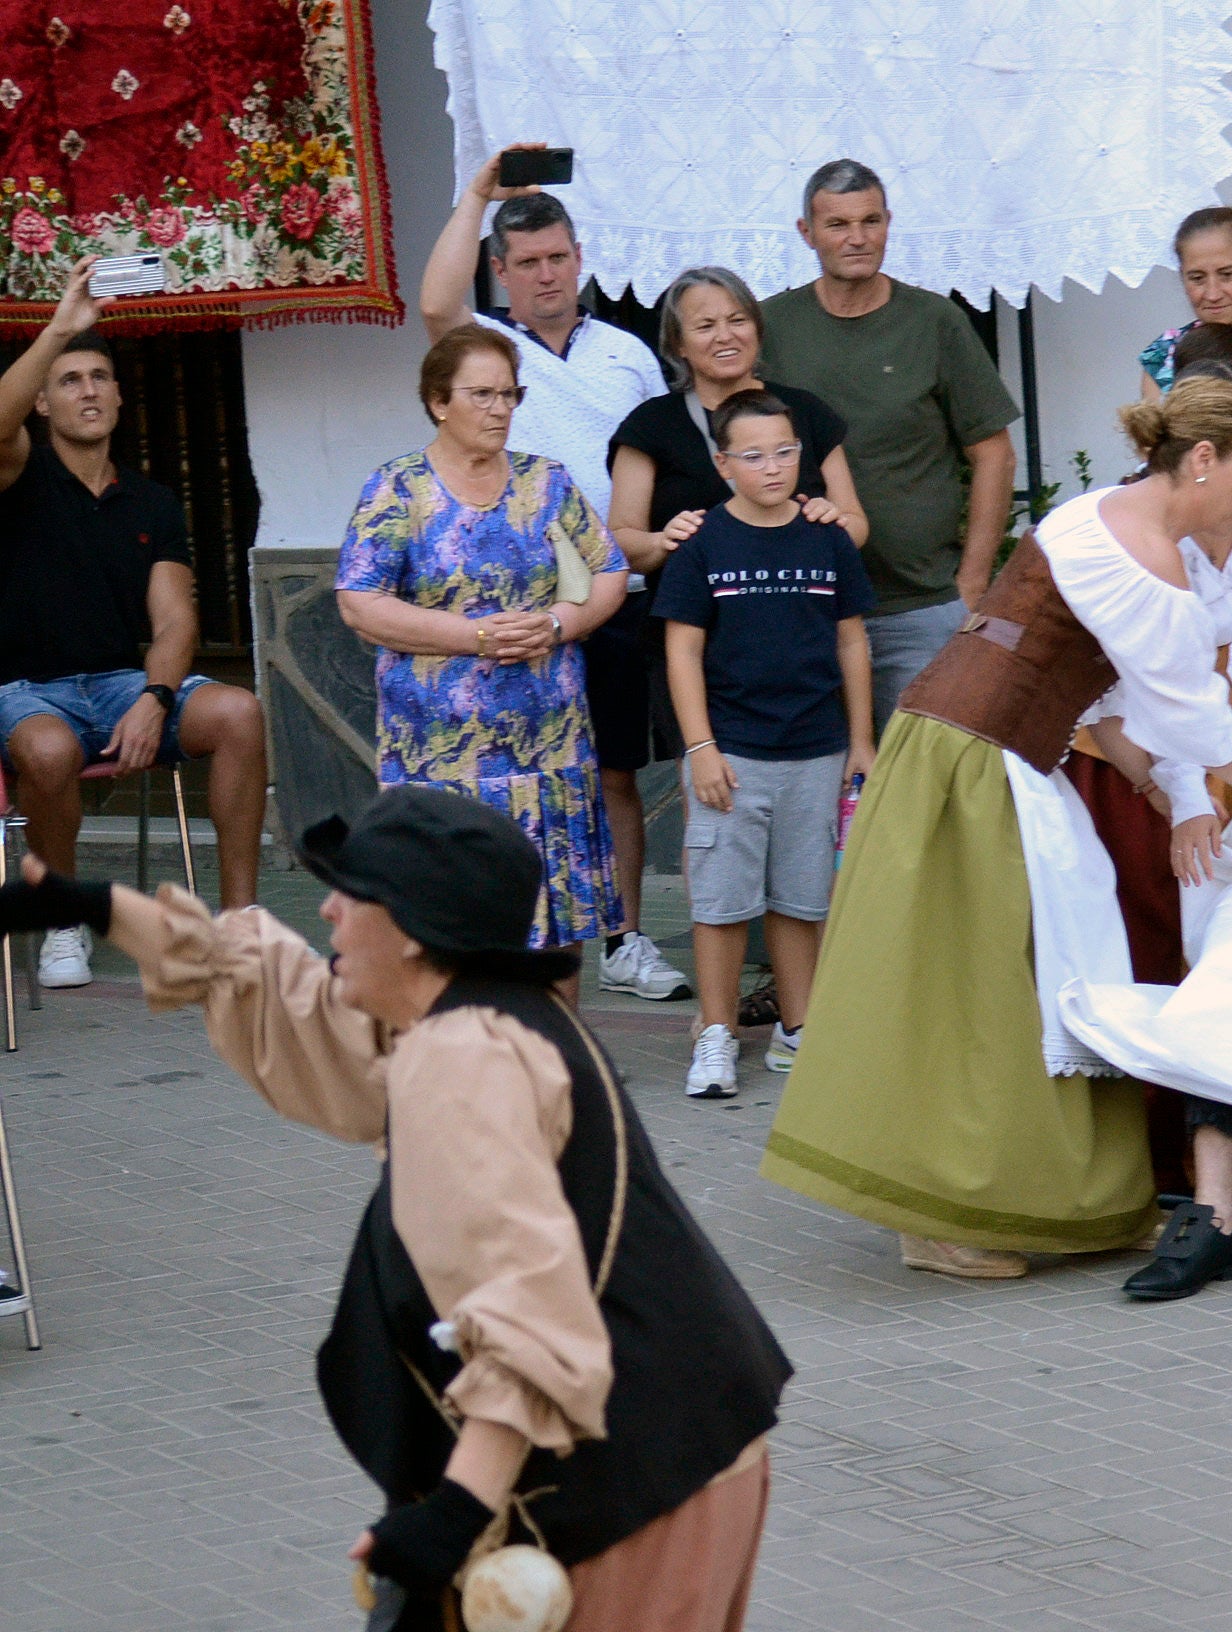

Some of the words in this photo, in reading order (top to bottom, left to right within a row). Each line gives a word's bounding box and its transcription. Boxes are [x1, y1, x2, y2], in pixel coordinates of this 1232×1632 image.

[707, 569, 769, 585] POLO
[778, 569, 837, 582] CLUB
[739, 586, 807, 595] ORIGINAL
